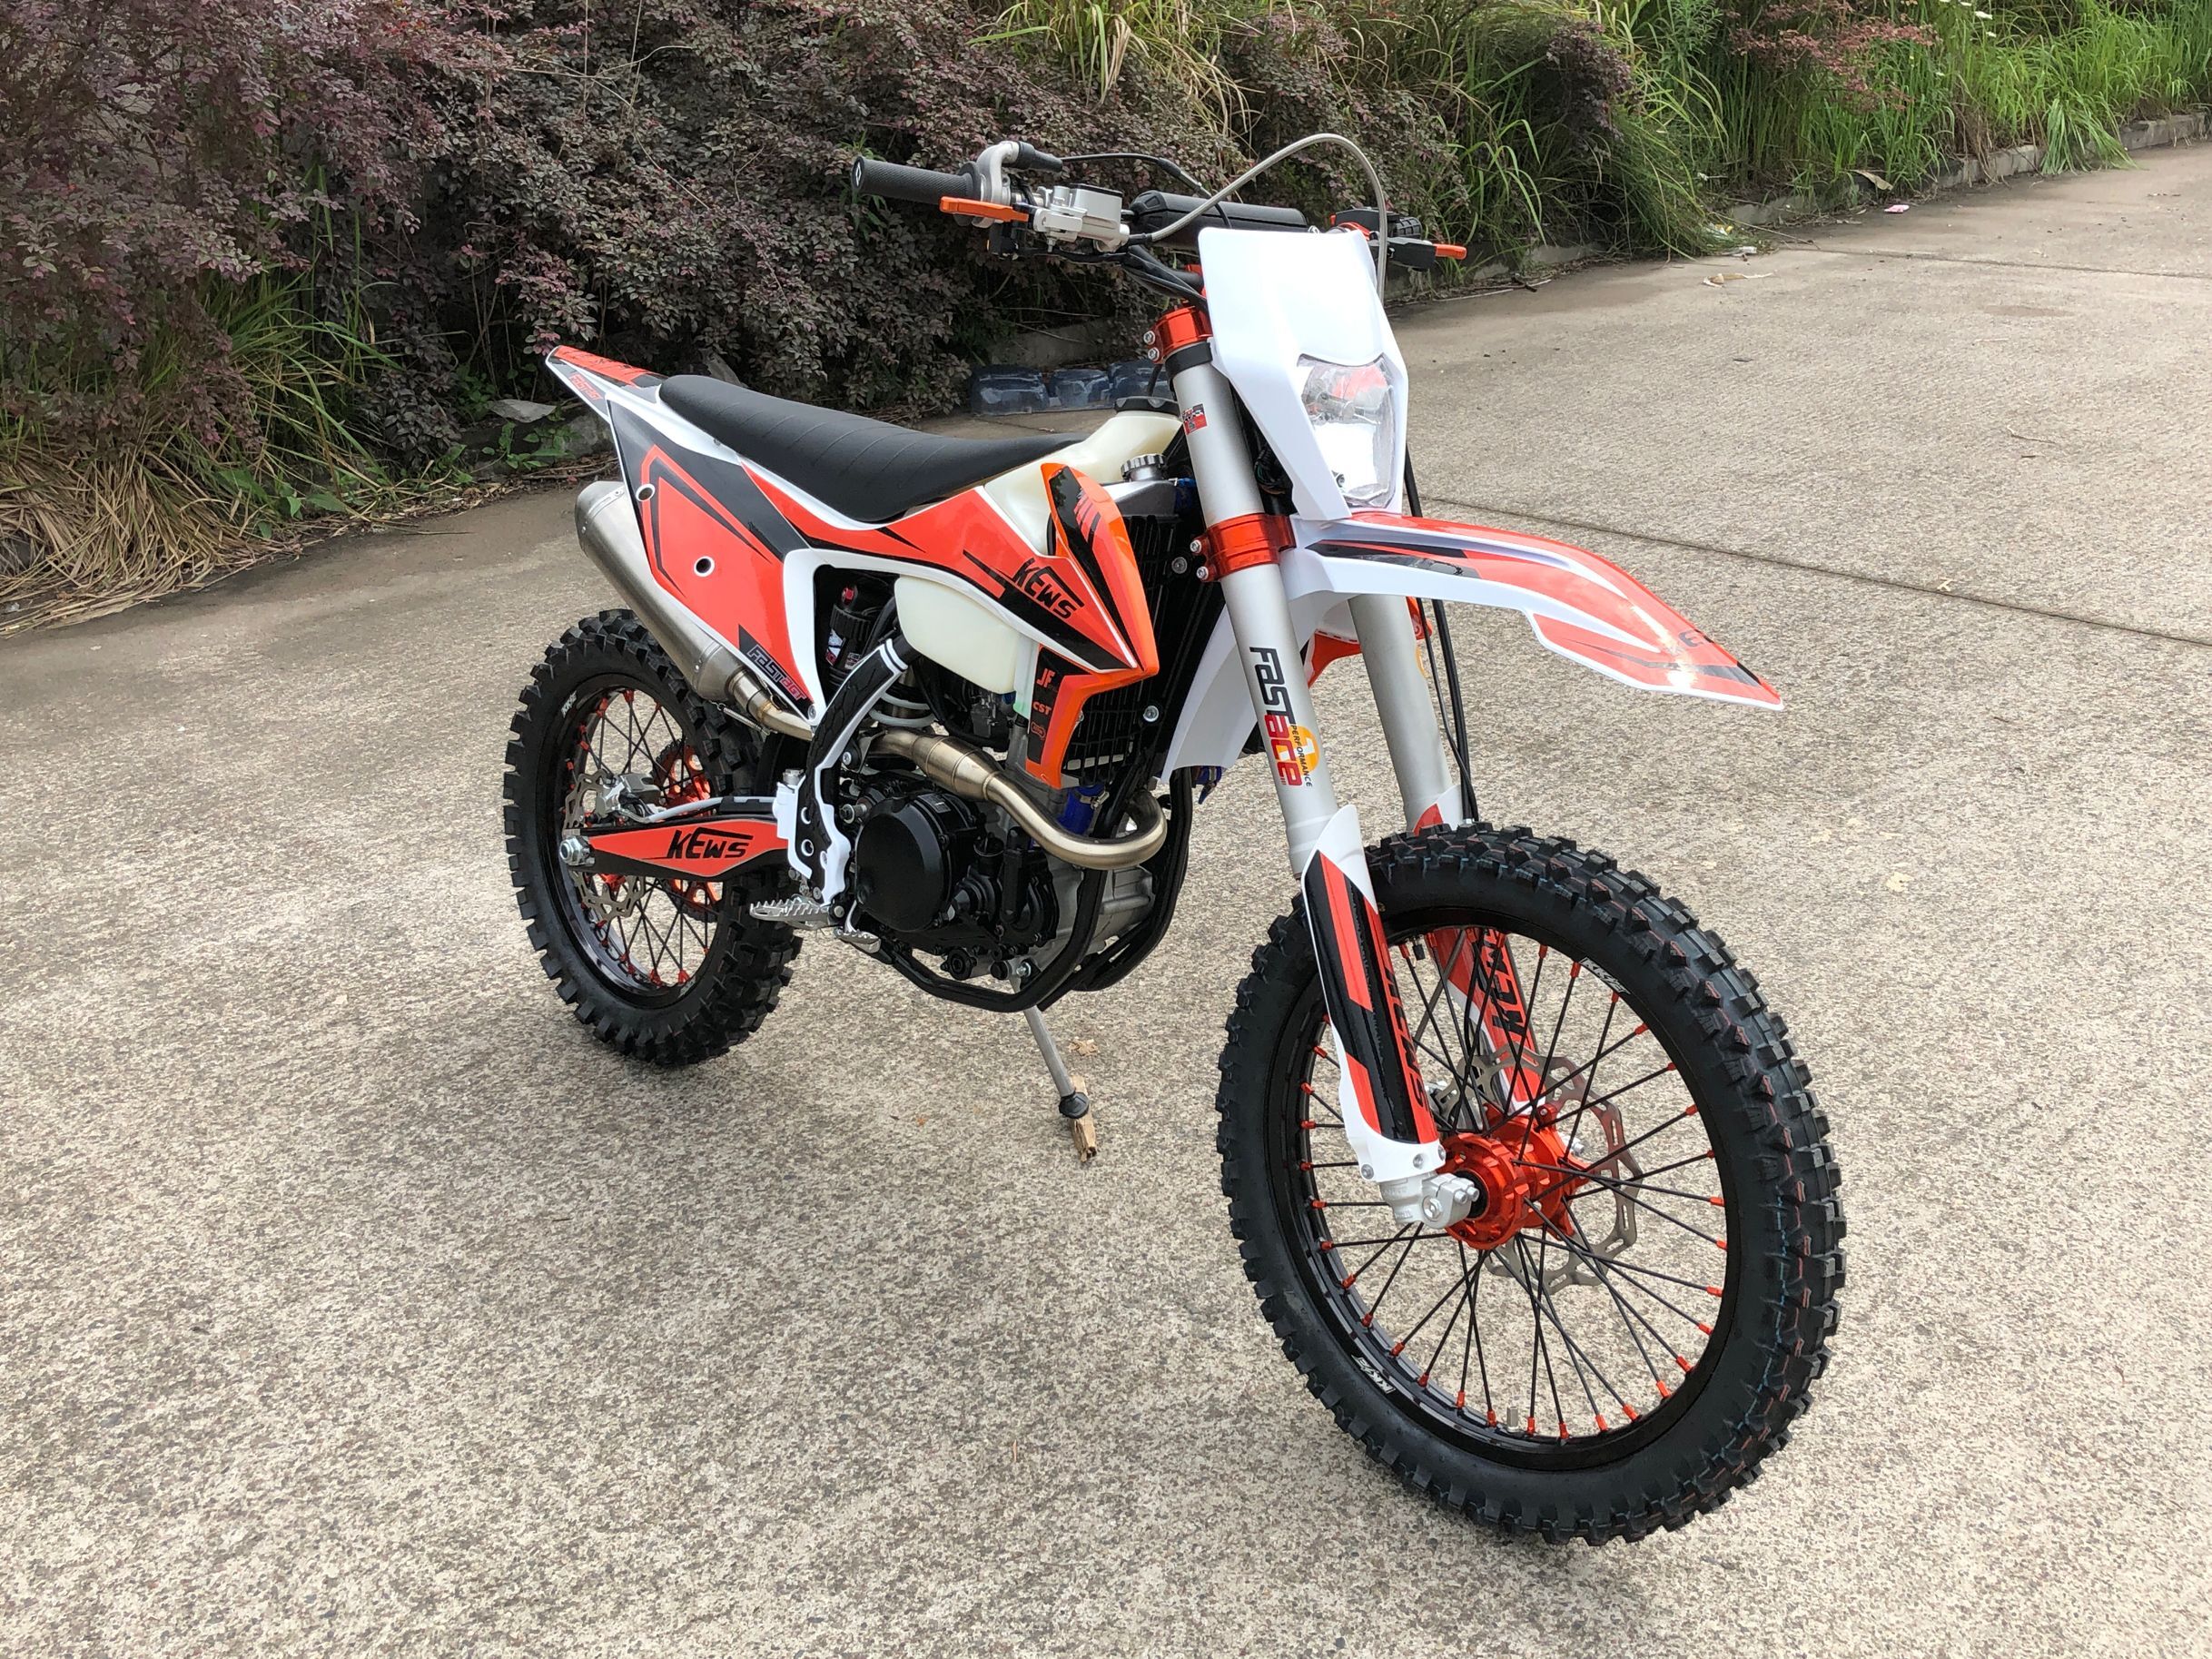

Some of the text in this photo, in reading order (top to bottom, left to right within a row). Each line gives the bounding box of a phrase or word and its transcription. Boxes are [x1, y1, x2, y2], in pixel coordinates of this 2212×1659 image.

[1012, 558, 1085, 619] KEWS
[1032, 701, 1052, 716] CST
[1290, 725, 1313, 787] PERFORMANCE
[667, 826, 754, 859] KEWS
